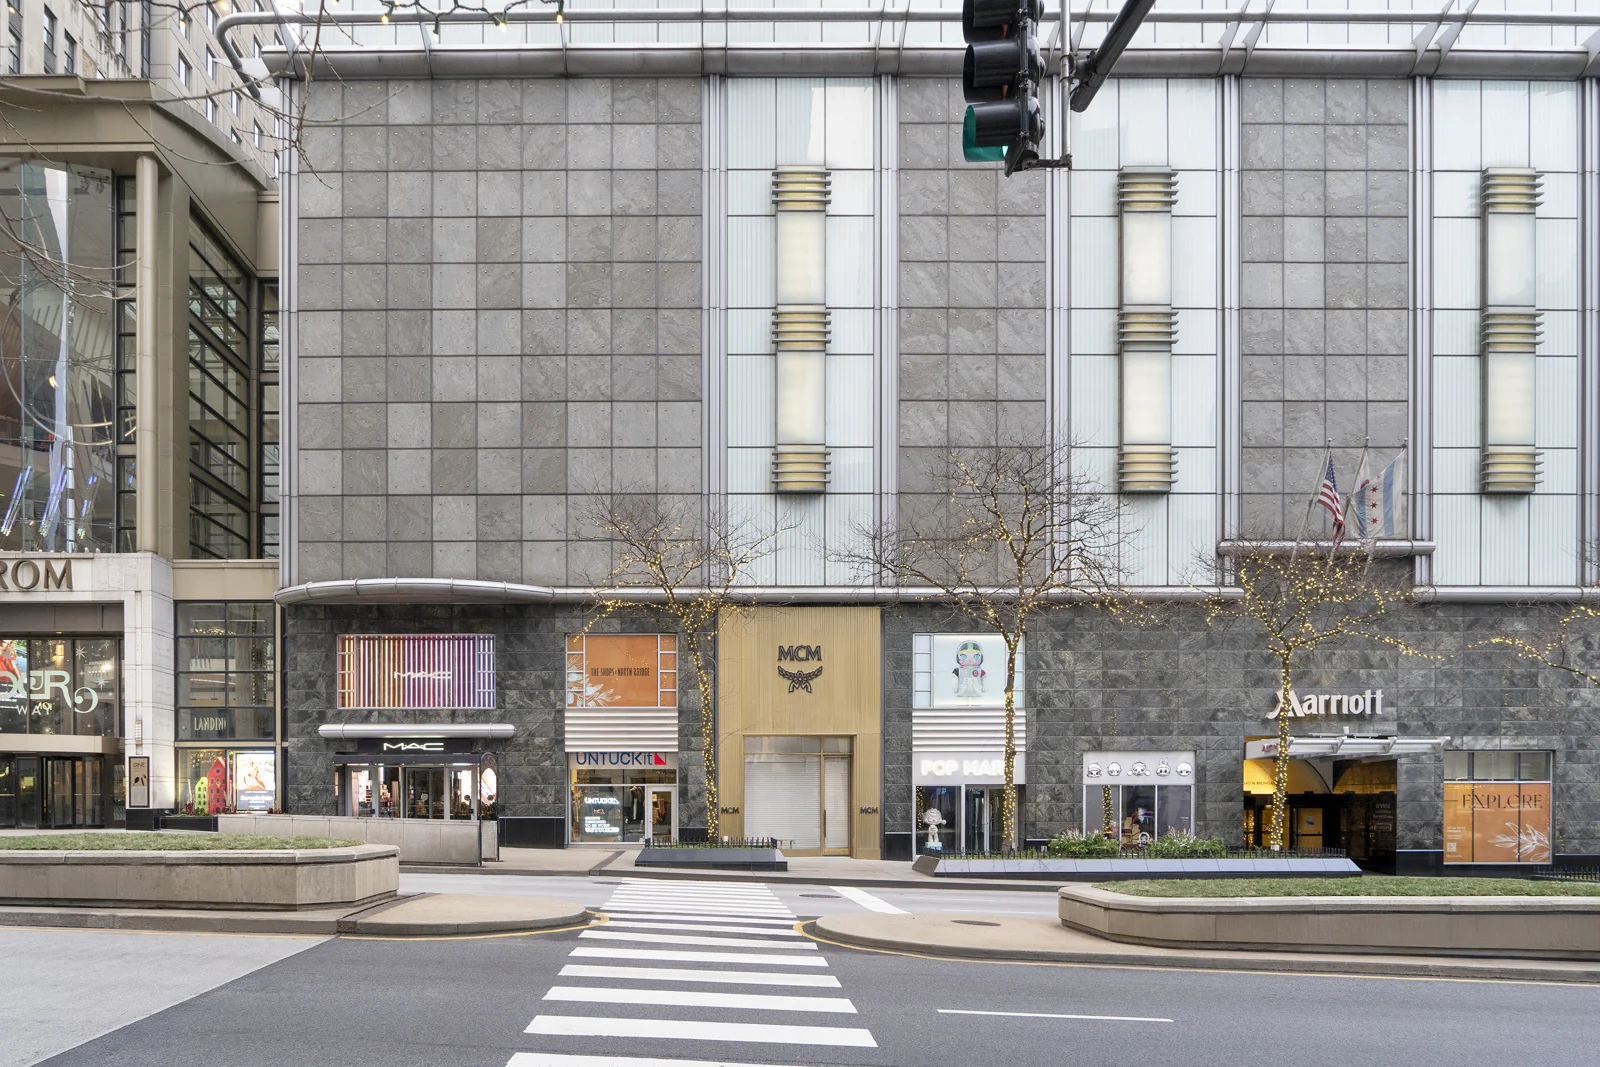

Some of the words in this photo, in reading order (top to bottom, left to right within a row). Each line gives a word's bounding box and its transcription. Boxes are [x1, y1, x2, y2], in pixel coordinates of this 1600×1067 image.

[777, 645, 822, 661] MCM
[591, 667, 599, 677] THE
[617, 667, 633, 677] NORTH
[16, 704, 51, 716] WAY
[1265, 689, 1384, 719] Marriott
[921, 760, 960, 777] POP
[963, 760, 1006, 776] MAR
[1462, 794, 1543, 809] EXPLORE
[720, 806, 740, 815] MCM
[859, 806, 879, 815] MCM
